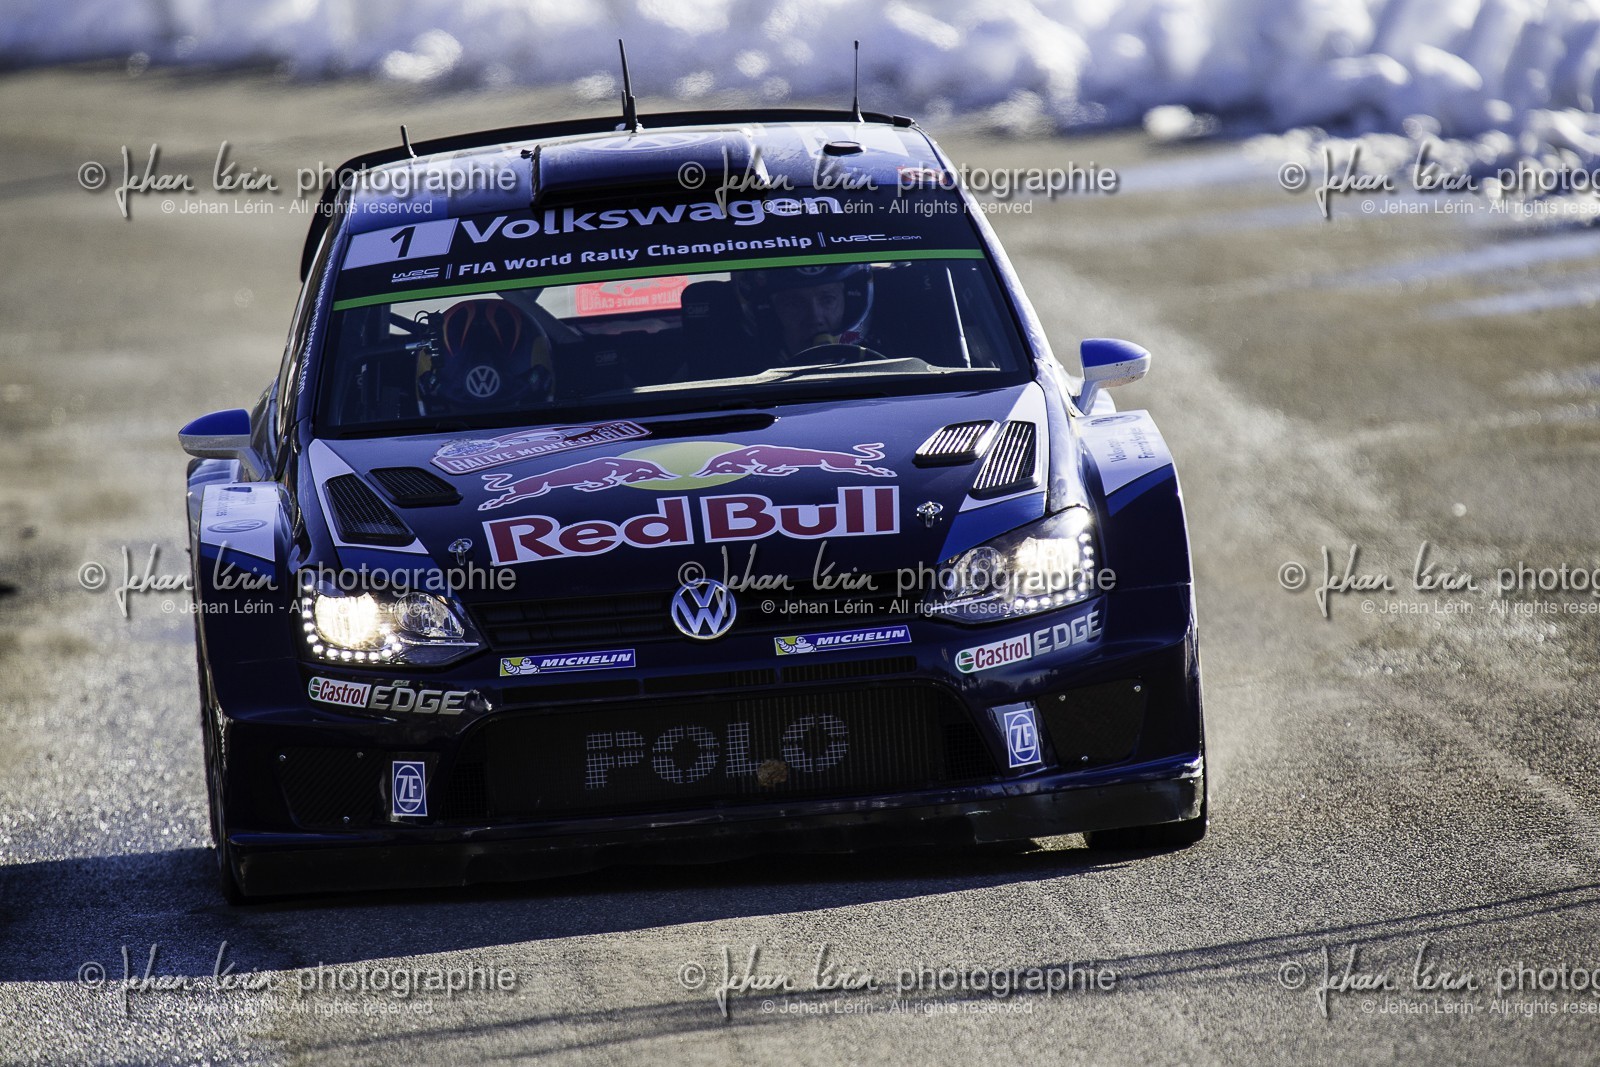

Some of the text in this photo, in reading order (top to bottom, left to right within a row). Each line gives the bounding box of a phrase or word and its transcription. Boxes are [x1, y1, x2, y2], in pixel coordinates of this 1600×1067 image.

[461, 196, 844, 243] Volkswagen
[390, 226, 416, 258] 1
[458, 261, 497, 276] FIA
[504, 253, 572, 271] World
[581, 248, 639, 262] Rally
[647, 235, 812, 257] Championship
[448, 451, 516, 472] RALLYE
[485, 486, 899, 565] Red Bull
[817, 628, 906, 646] MICHELIN
[975, 610, 1102, 668] Castrol EDGE
[541, 652, 632, 668] MICHELIN
[319, 680, 470, 715] Castrol EDGE
[585, 712, 850, 790] POLO
[1011, 722, 1036, 753] ZF
[397, 775, 423, 803] ZF
